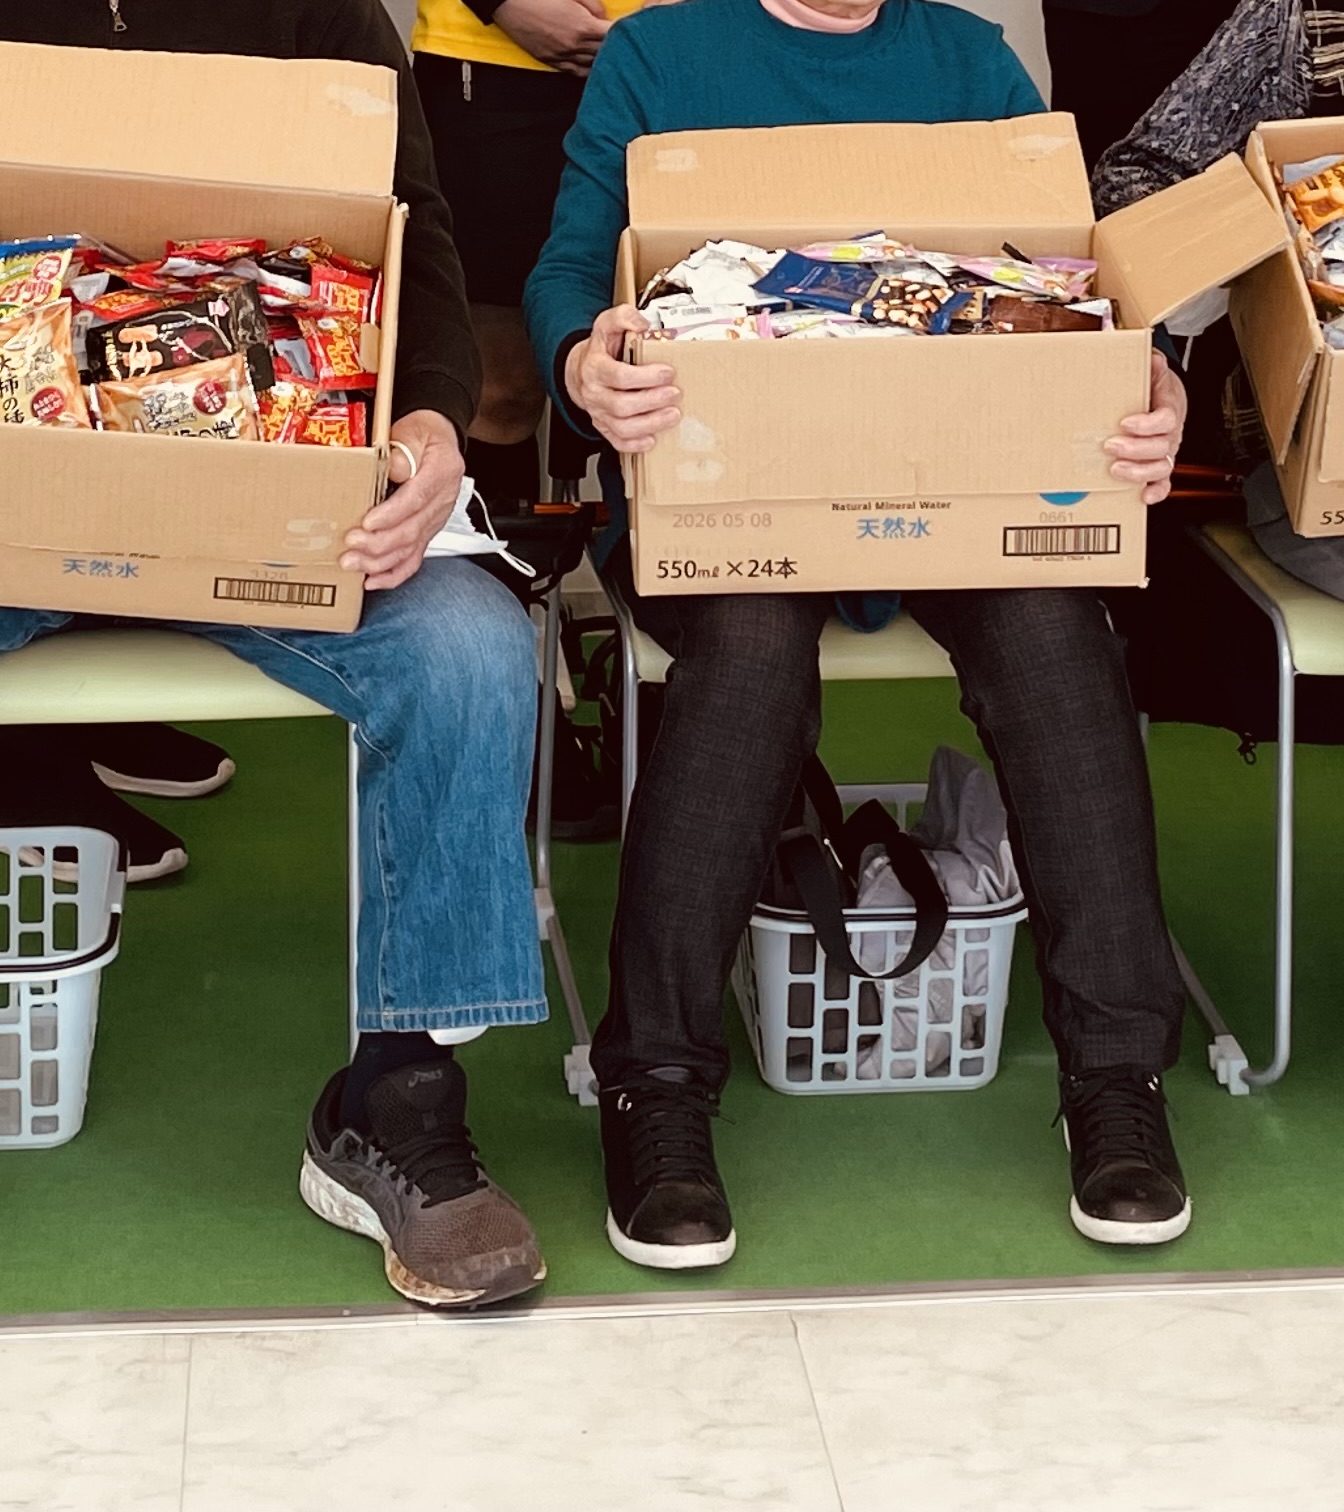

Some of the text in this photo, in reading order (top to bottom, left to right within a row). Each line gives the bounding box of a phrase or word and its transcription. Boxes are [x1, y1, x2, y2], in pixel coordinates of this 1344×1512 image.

[832, 500, 952, 511] Natural Mineral Water
[672, 512, 772, 528] 2026 05 08
[856, 516, 931, 539] 天然水
[63, 558, 140, 579] 天然水
